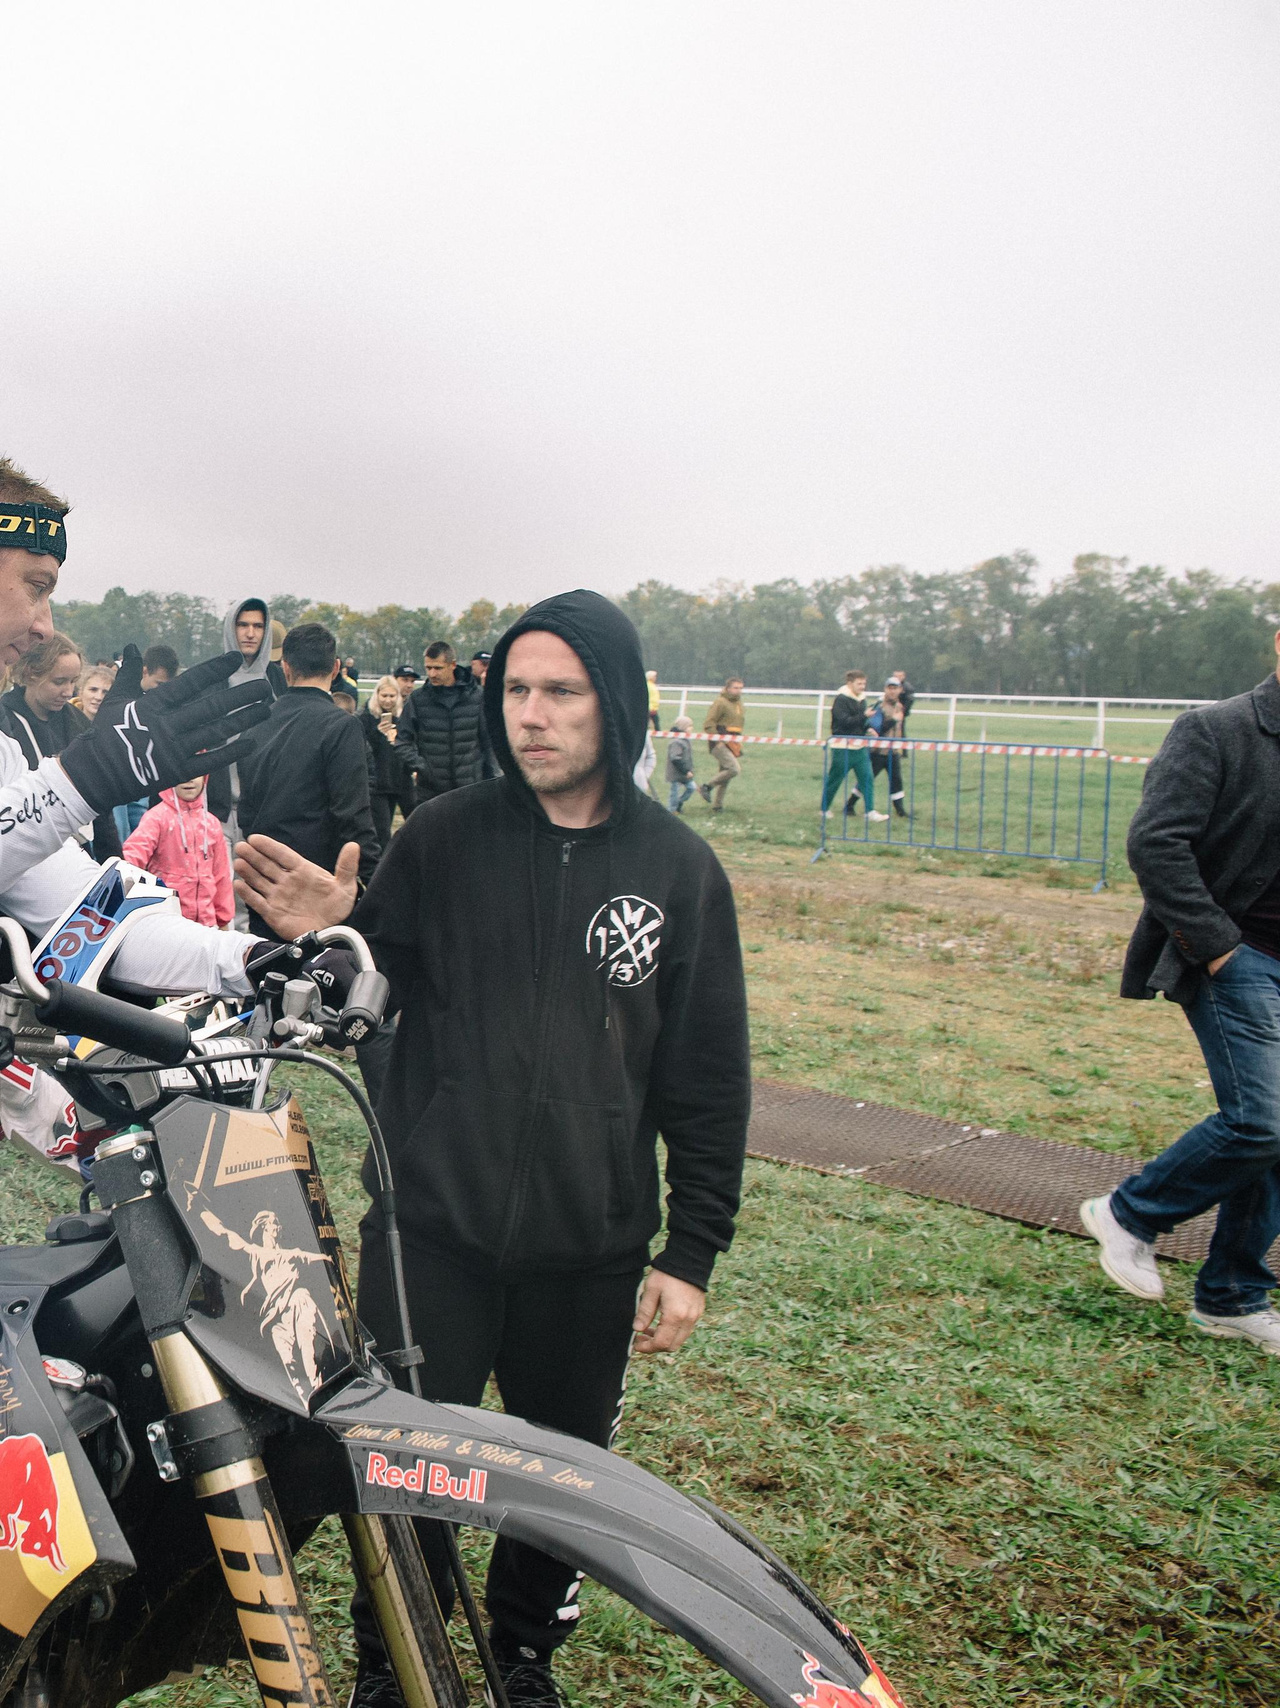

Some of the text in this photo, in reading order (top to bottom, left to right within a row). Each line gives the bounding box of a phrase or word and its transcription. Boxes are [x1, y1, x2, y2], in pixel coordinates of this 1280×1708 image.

[343, 1424, 596, 1490] Live to Ride & Ride to Live
[366, 1451, 488, 1504] Red Bull
